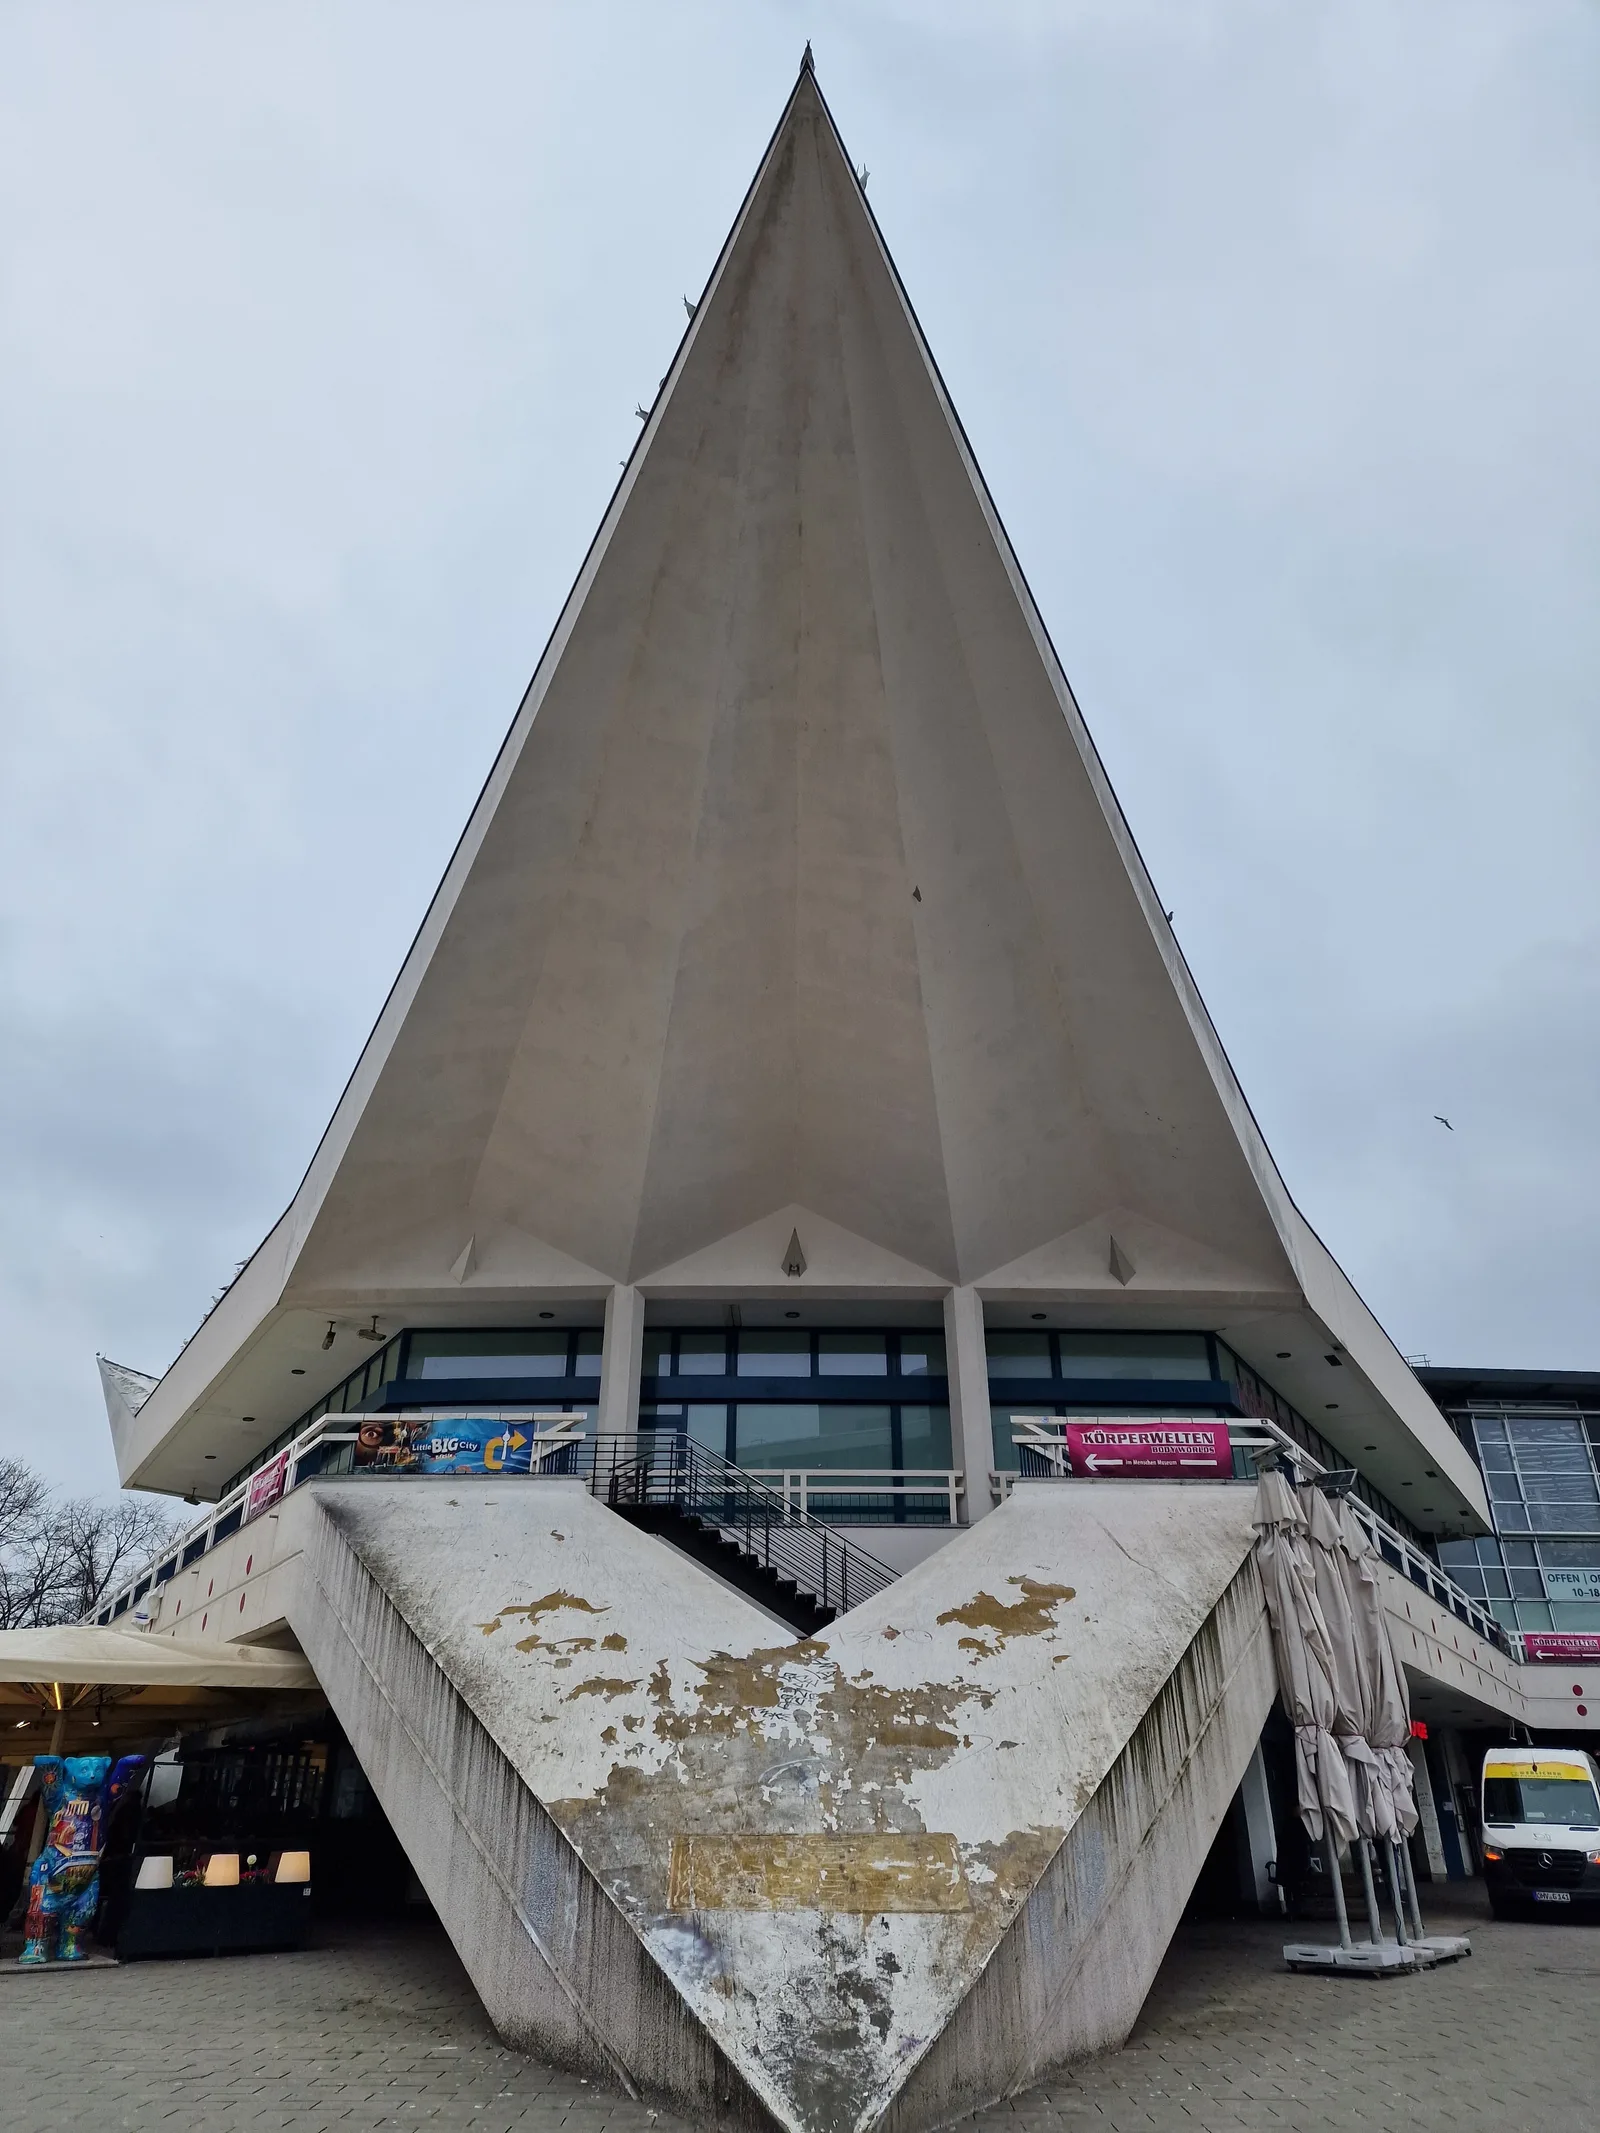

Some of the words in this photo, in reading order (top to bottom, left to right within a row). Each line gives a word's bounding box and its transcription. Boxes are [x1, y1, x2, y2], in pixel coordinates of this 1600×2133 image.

[1082, 1430, 1215, 1445] KÖRPERWELTEN
[431, 1438, 459, 1453] BIG
[459, 1441, 478, 1451] City
[1548, 1573, 1580, 1583] OFFEN
